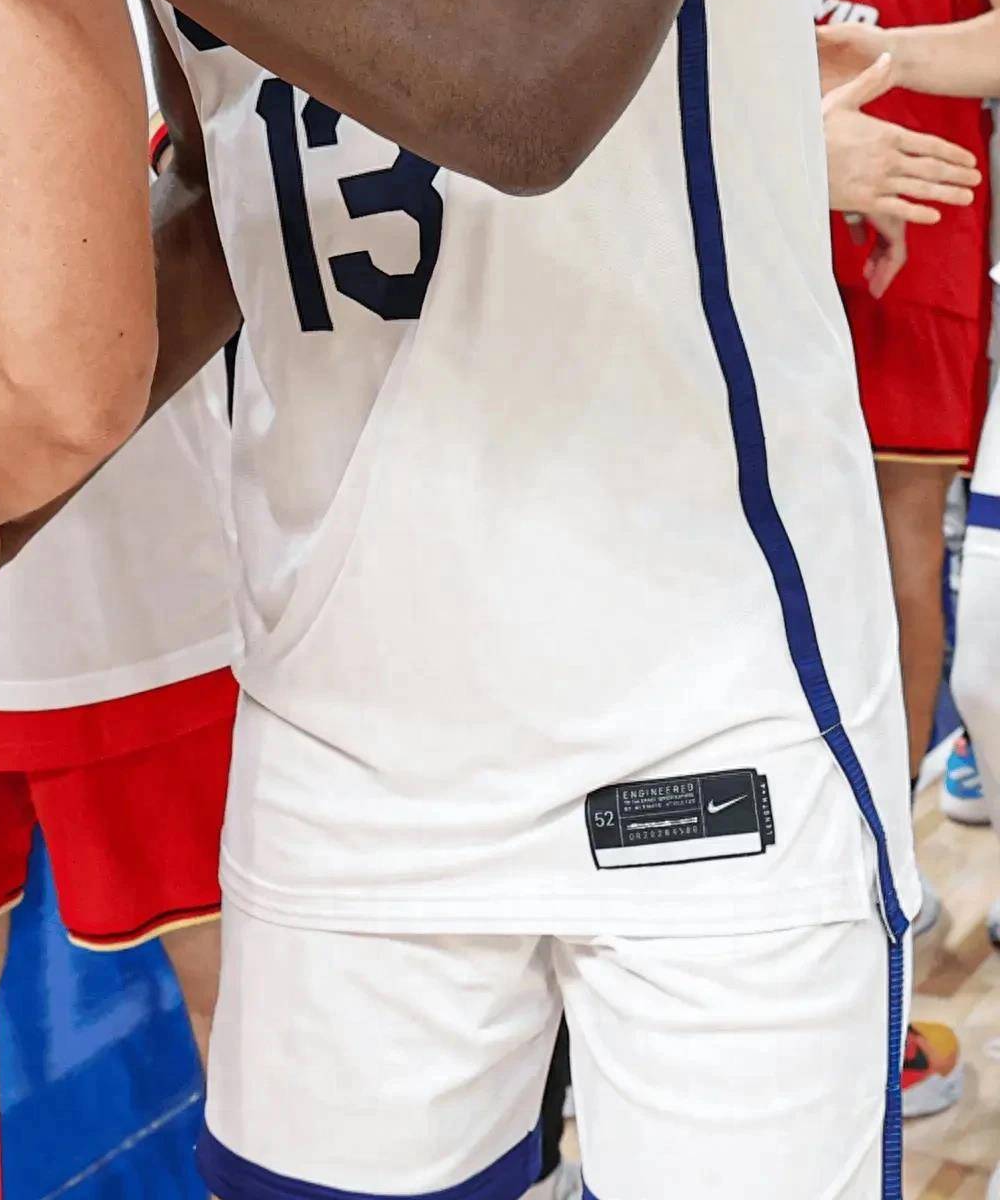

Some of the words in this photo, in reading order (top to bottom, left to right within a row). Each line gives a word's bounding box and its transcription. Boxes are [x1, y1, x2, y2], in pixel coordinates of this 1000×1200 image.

[255, 76, 445, 333] 13
[622, 782, 694, 800] ENGINEERED
[594, 810, 616, 828] 52
